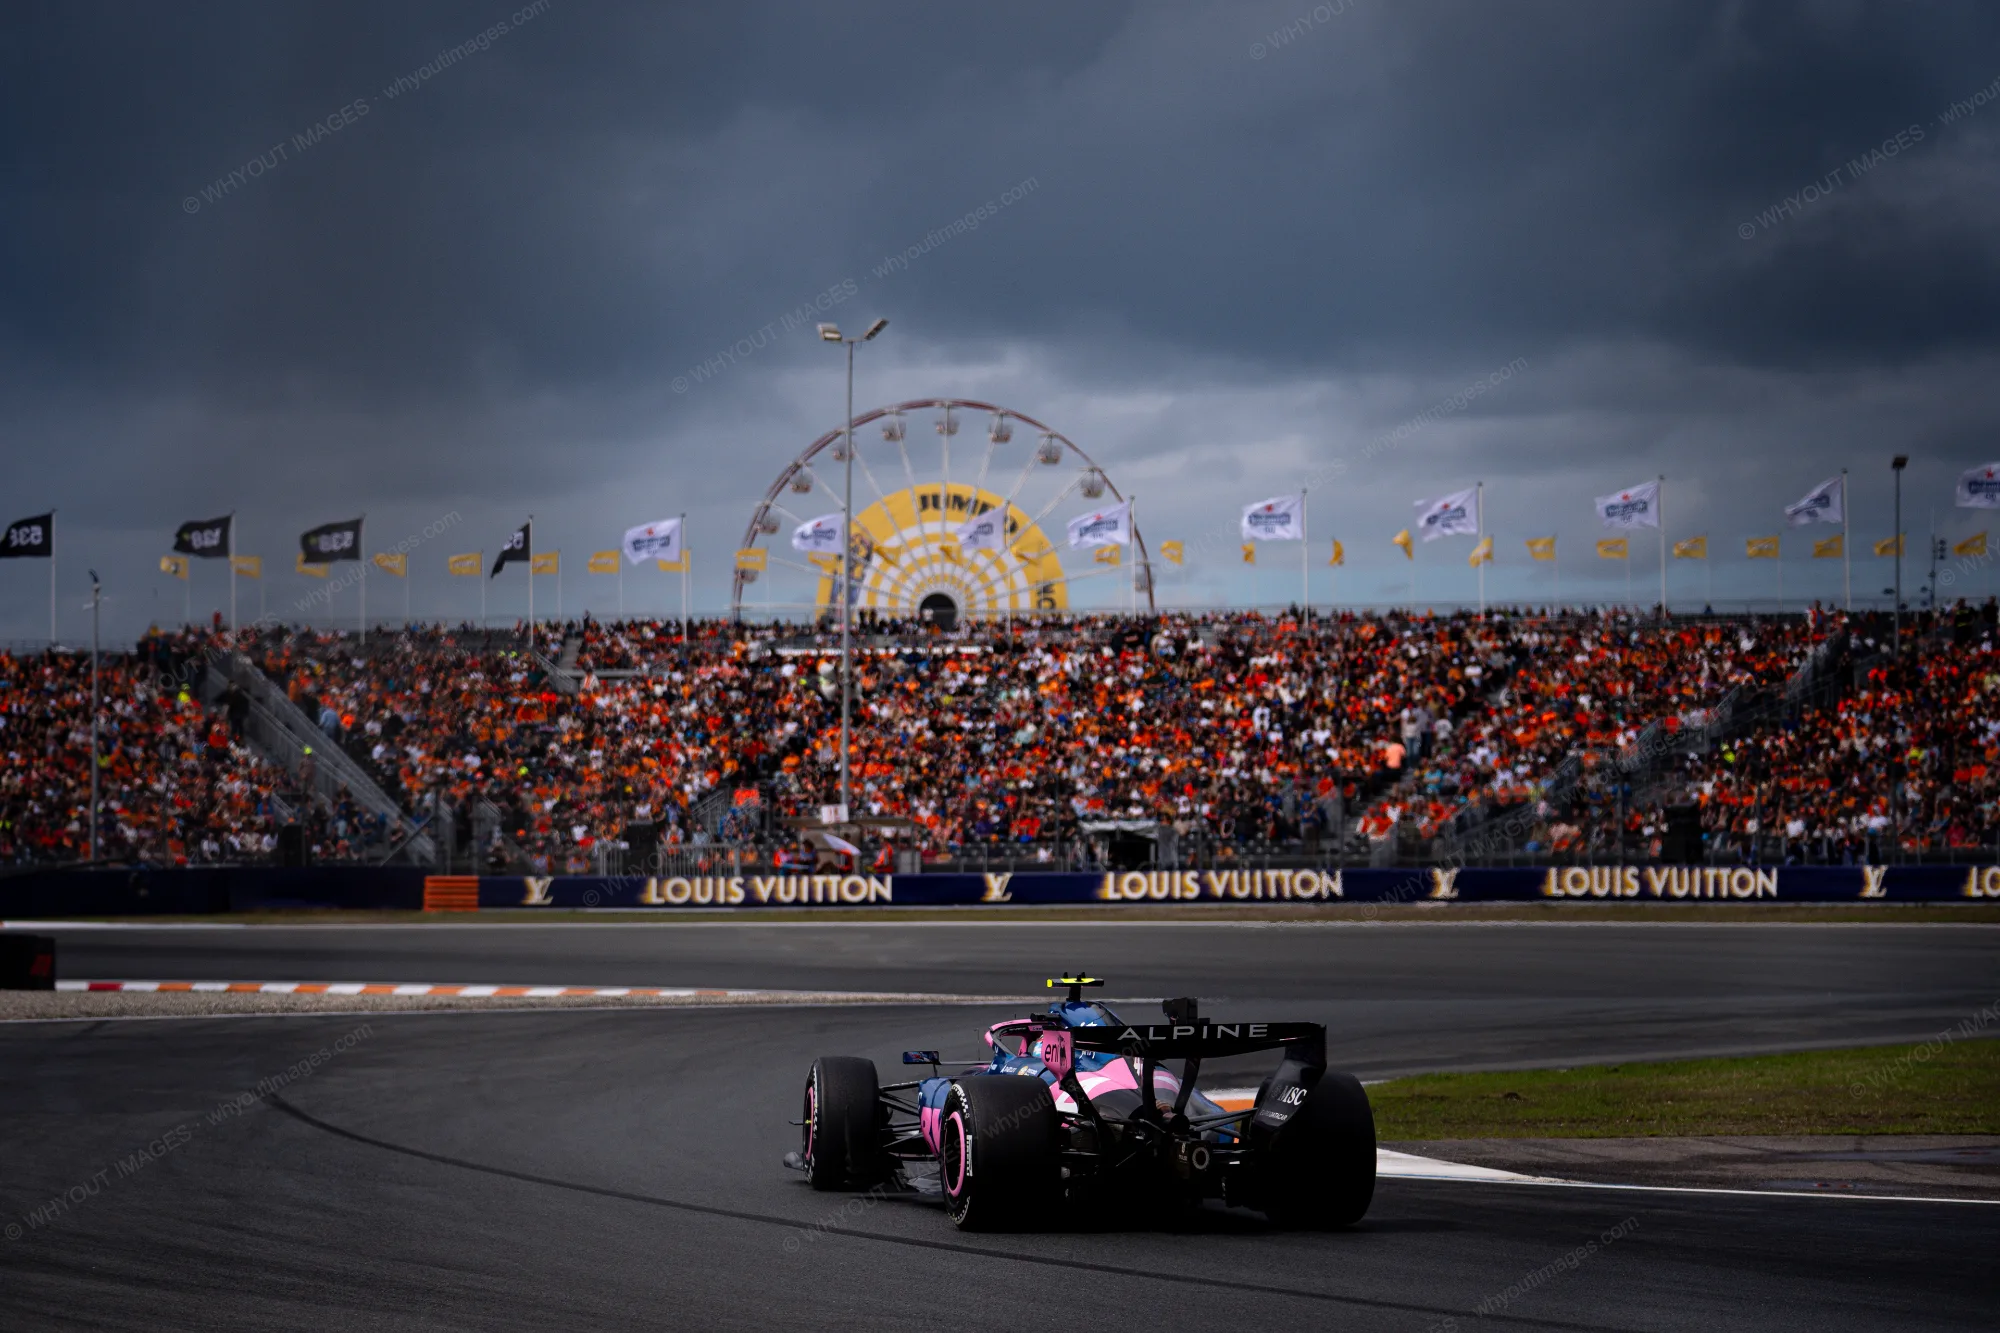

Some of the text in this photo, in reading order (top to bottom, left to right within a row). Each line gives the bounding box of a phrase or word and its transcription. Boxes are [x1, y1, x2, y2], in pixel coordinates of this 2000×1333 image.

[649, 874, 893, 904] LOUIS VUITTON
[1104, 868, 1343, 900] LOUIS VUITTON
[1547, 866, 1778, 898] LOUIS VUITTON
[1117, 1024, 1268, 1041] ALPINE
[1044, 1043, 1060, 1062] eni
[1276, 1086, 1307, 1106] MSC
